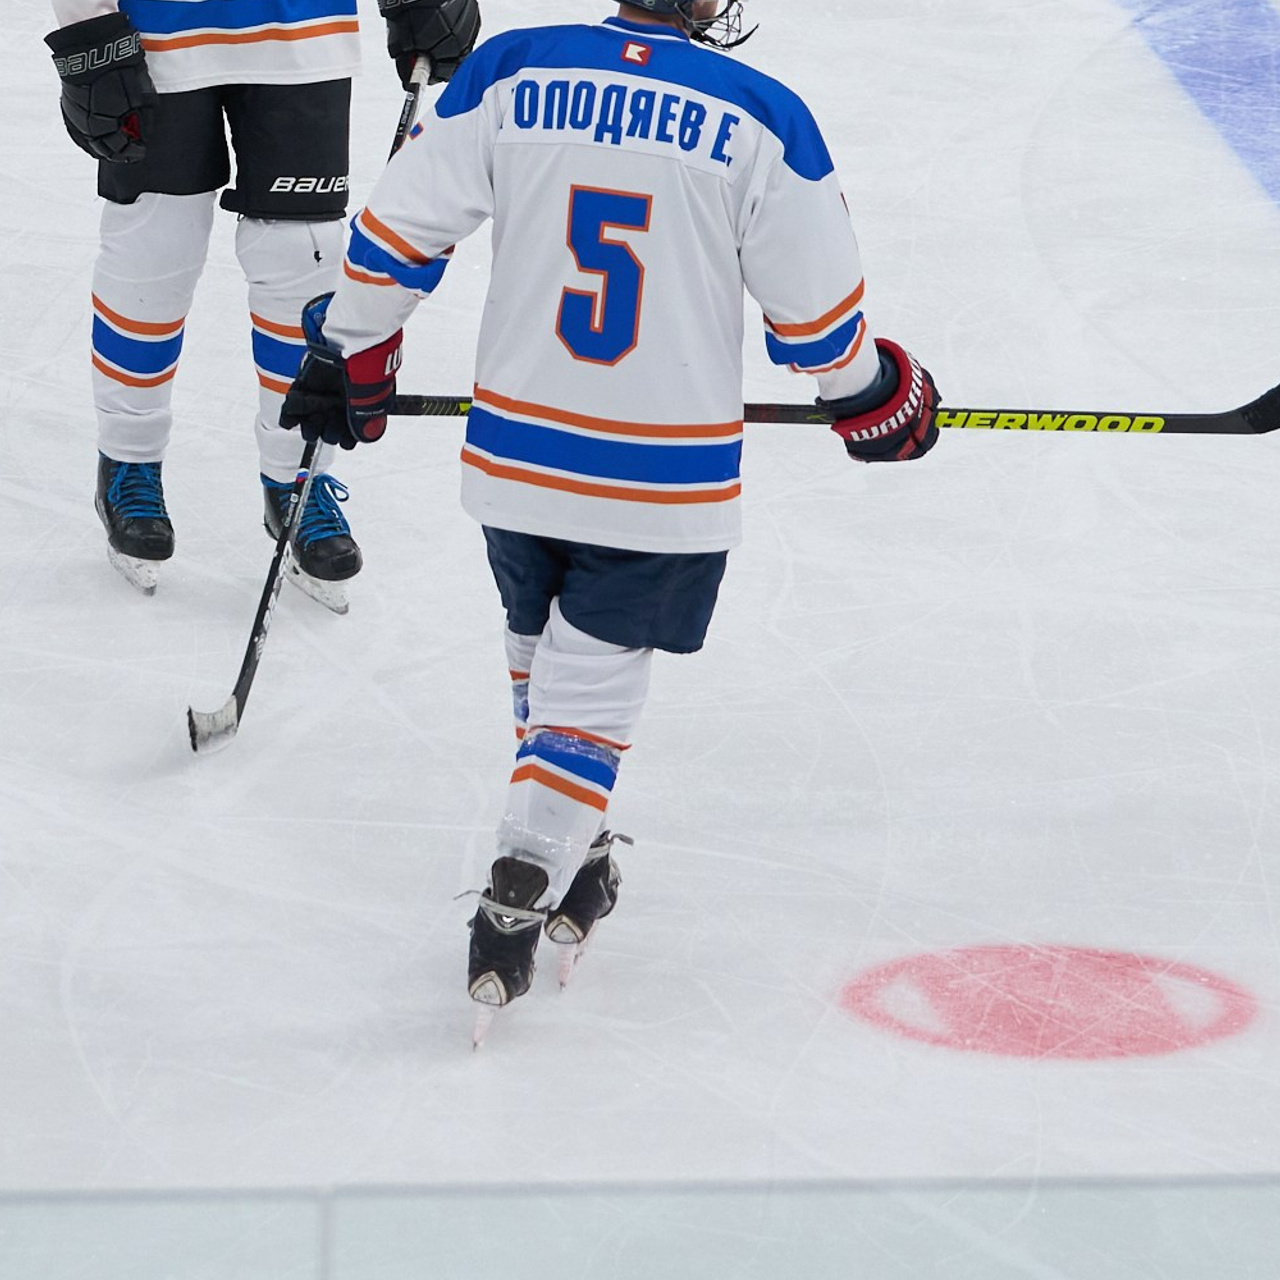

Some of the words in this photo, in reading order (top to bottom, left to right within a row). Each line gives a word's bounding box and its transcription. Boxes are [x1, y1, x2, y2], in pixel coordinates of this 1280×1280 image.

[501, 80, 707, 151] ОЛОДЯЕВ
[269, 176, 348, 193] BAUE
[555, 184, 653, 367] 5
